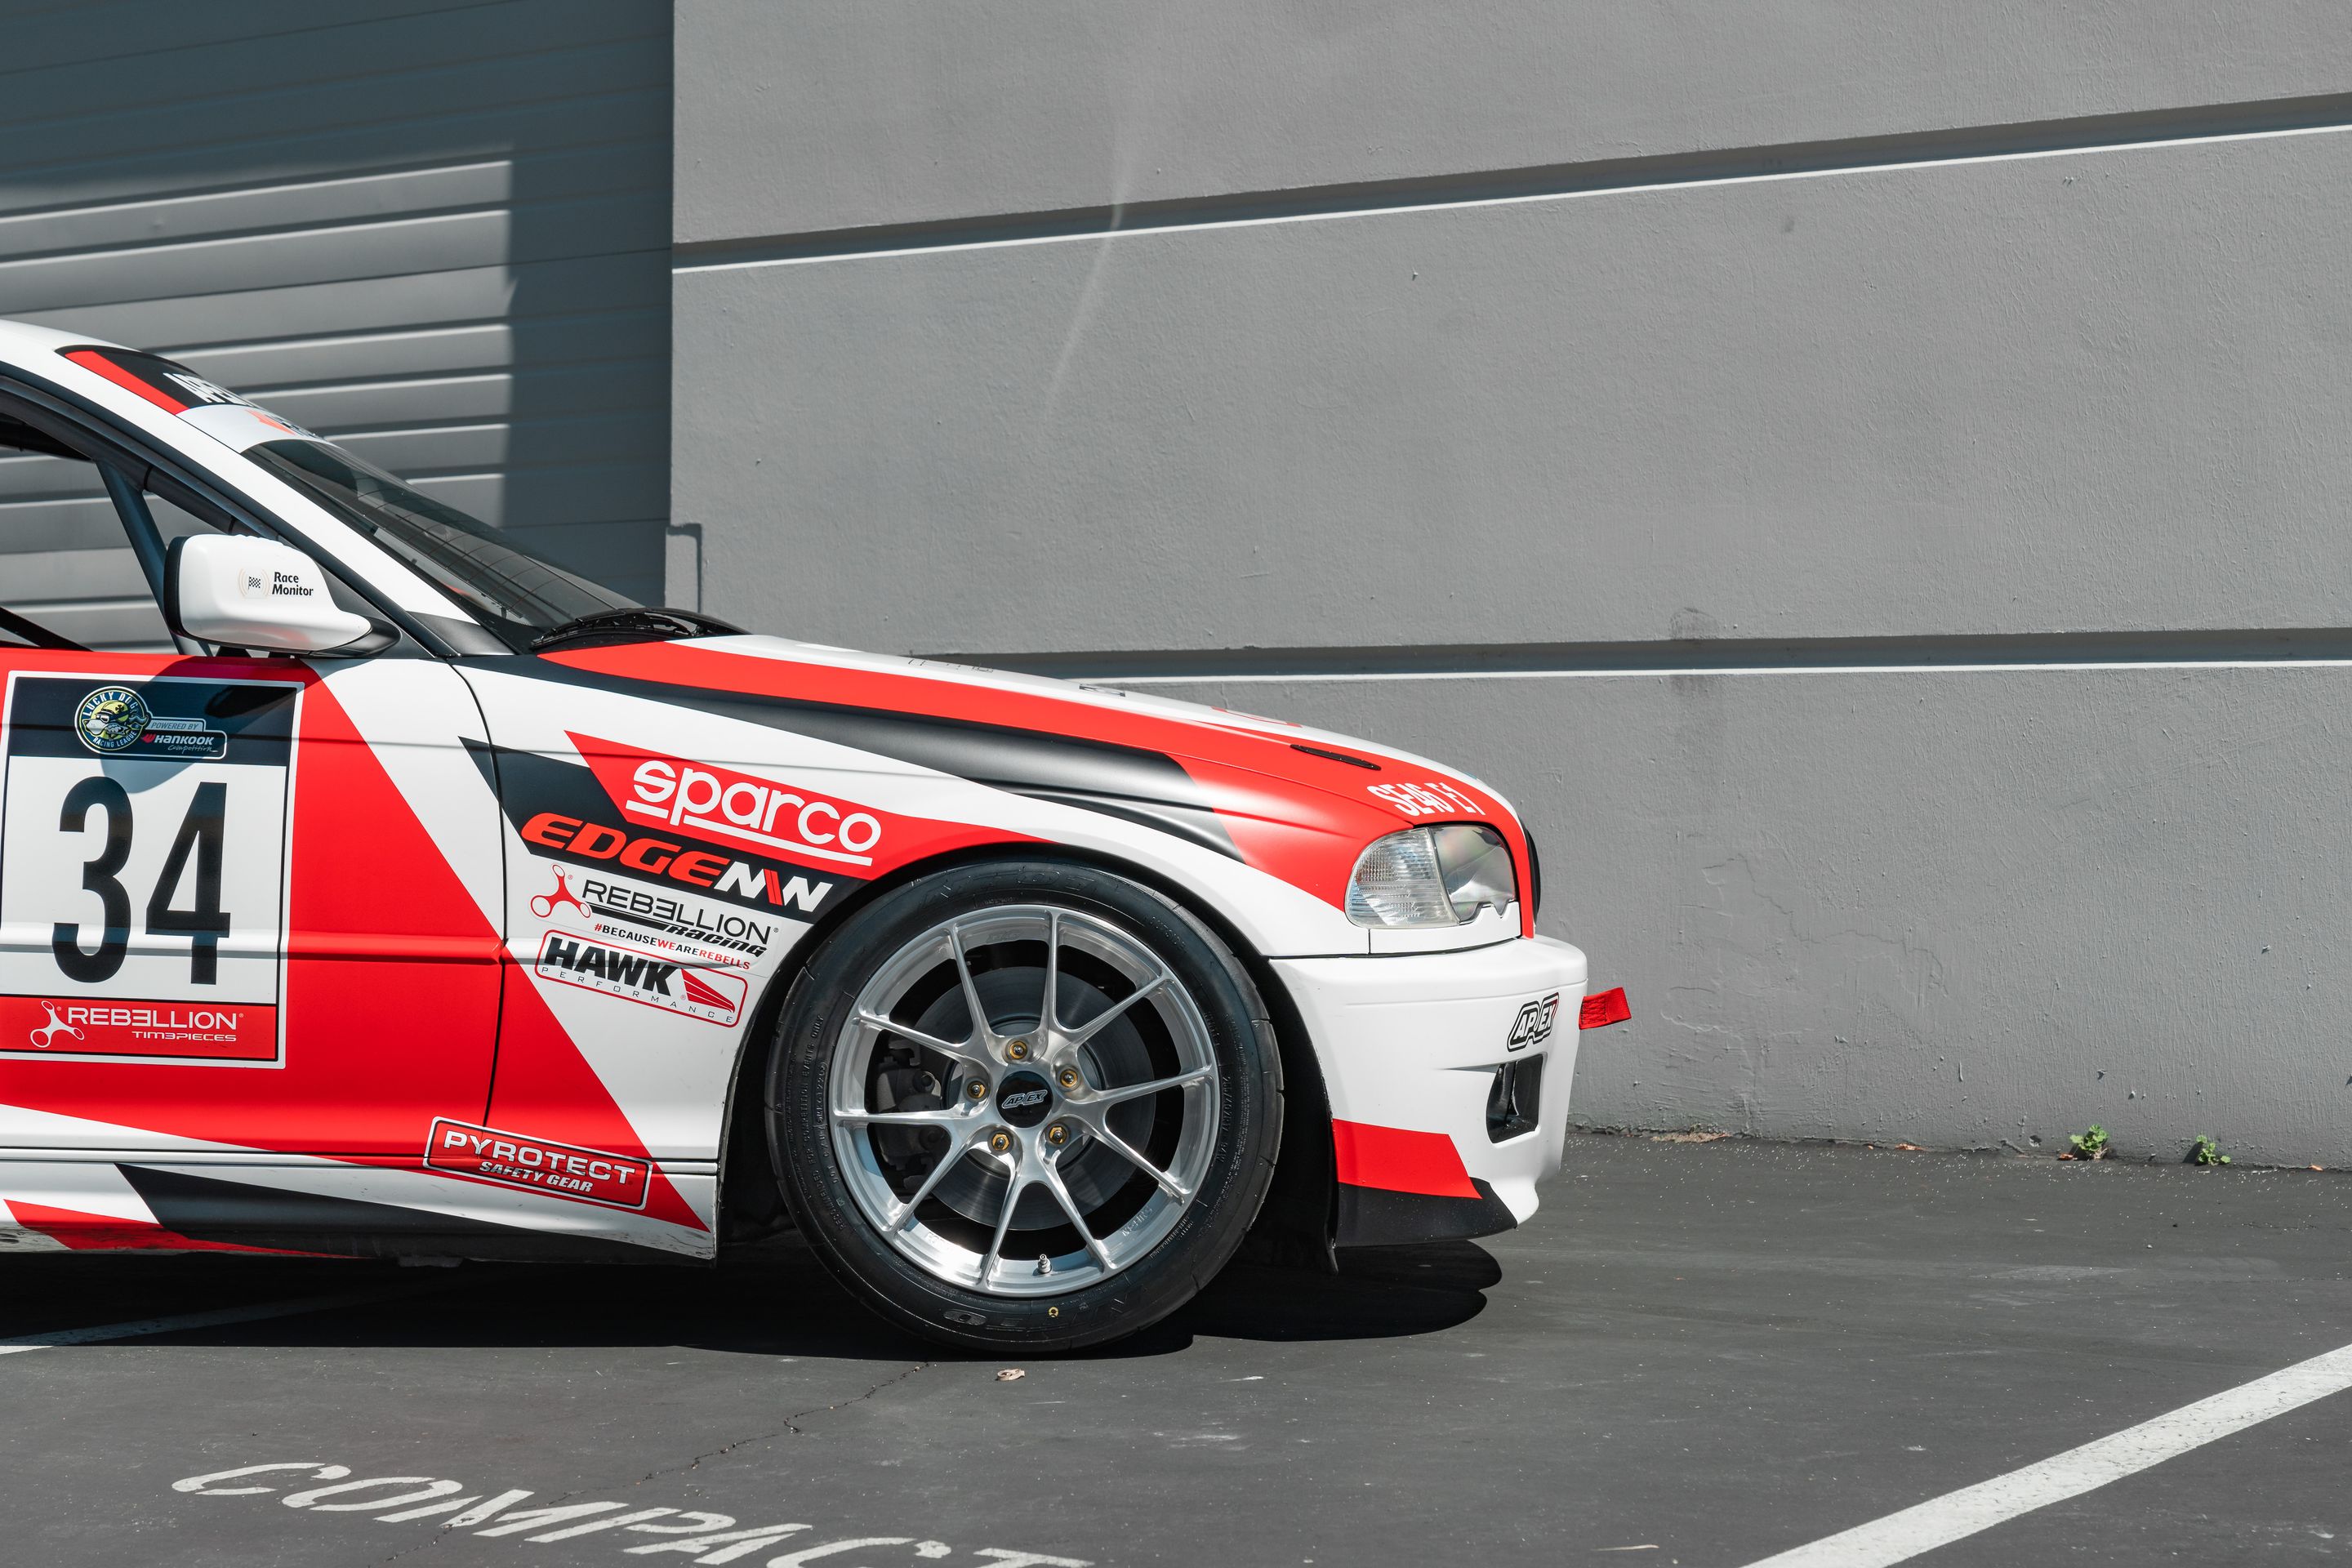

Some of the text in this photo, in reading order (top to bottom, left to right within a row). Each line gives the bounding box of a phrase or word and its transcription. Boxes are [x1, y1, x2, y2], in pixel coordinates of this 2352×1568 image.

[272, 584, 314, 597] Monitor
[274, 572, 299, 584] Race
[82, 692, 139, 716] LUCKY DOG
[92, 730, 138, 748] RACING LEAGUE
[150, 722, 187, 730] POWERED
[632, 760, 882, 853] sparco
[51, 776, 231, 985] 34
[544, 936, 681, 997] HAWK
[540, 966, 733, 1023] PERFORMANCE
[1003, 1090, 1046, 1108] APEX
[443, 1129, 636, 1185] PYROTECT
[479, 1160, 594, 1193] SAFETY GEAR
